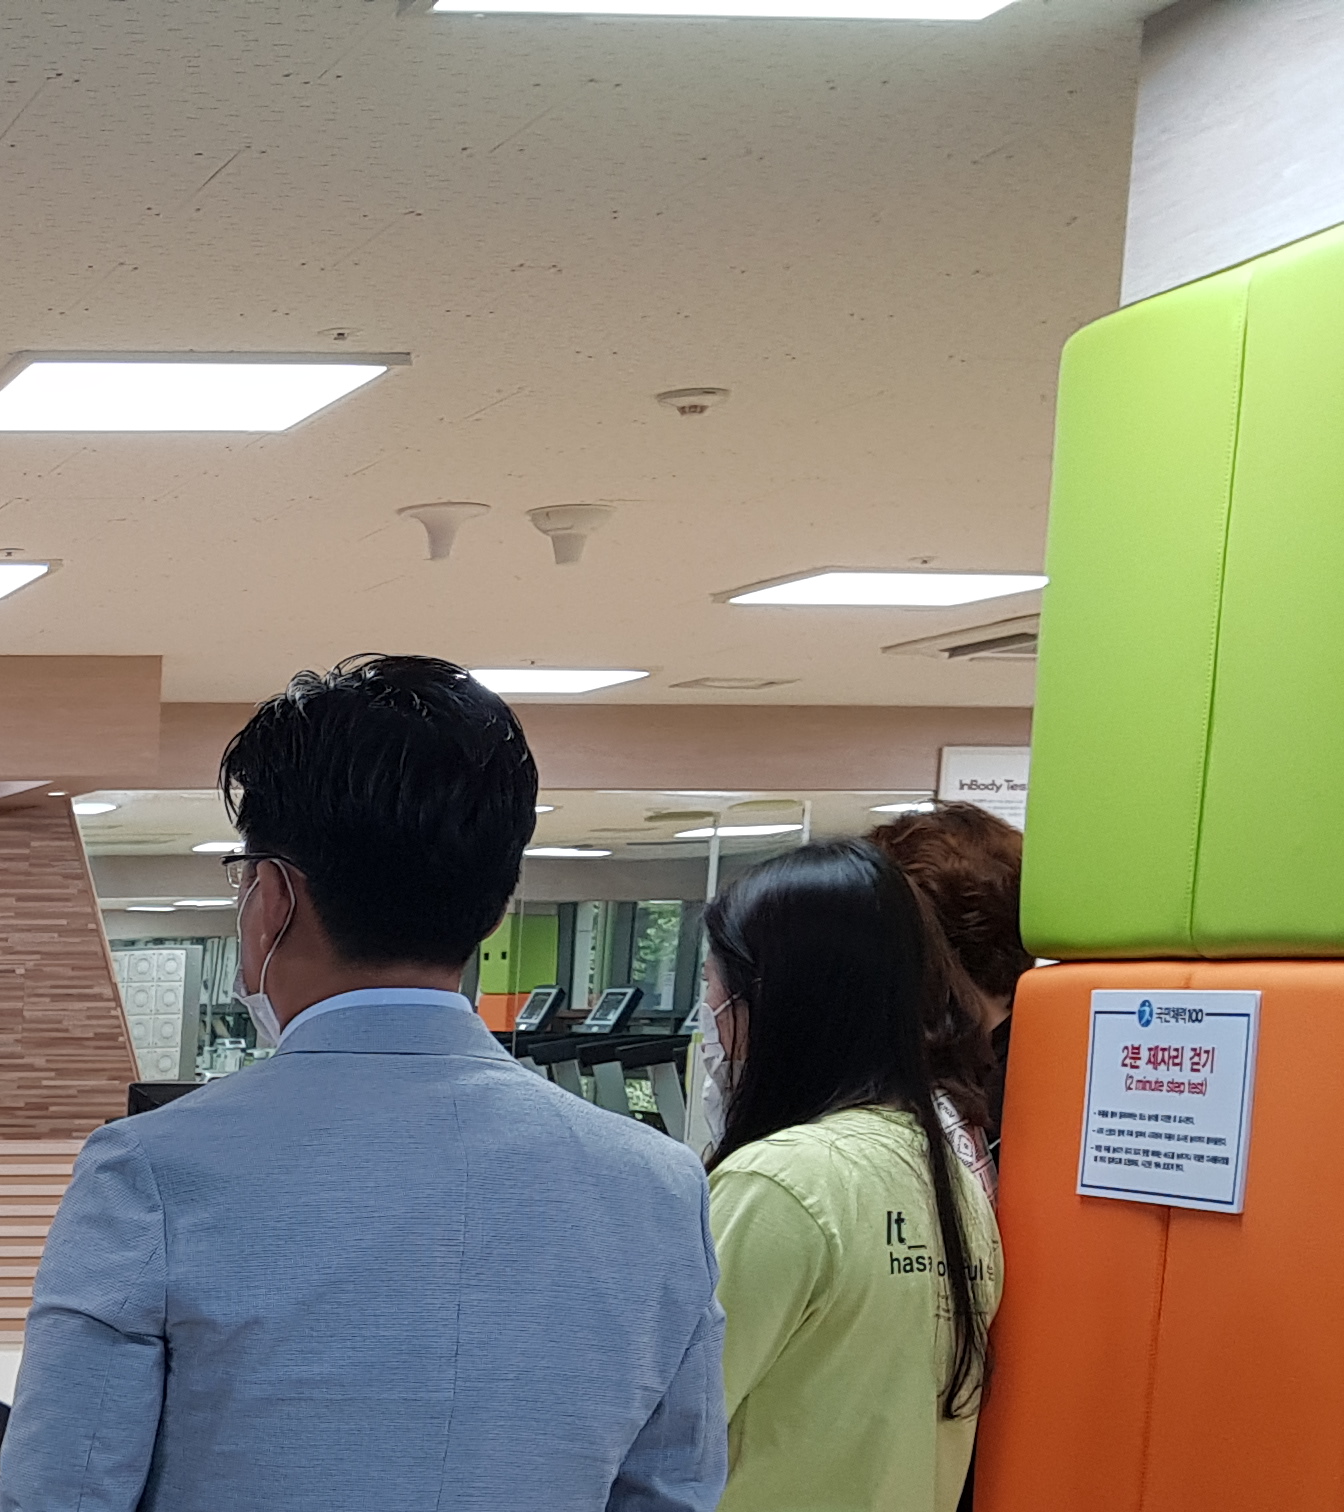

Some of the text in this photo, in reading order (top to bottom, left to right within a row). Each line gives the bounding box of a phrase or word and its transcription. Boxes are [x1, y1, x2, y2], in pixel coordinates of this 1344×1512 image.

[958, 779, 1003, 794] InBody
[1120, 1043, 1216, 1074] 2분 제자리 걷기
[1134, 1075, 1164, 1093] minute
[1165, 1077, 1186, 1096] step
